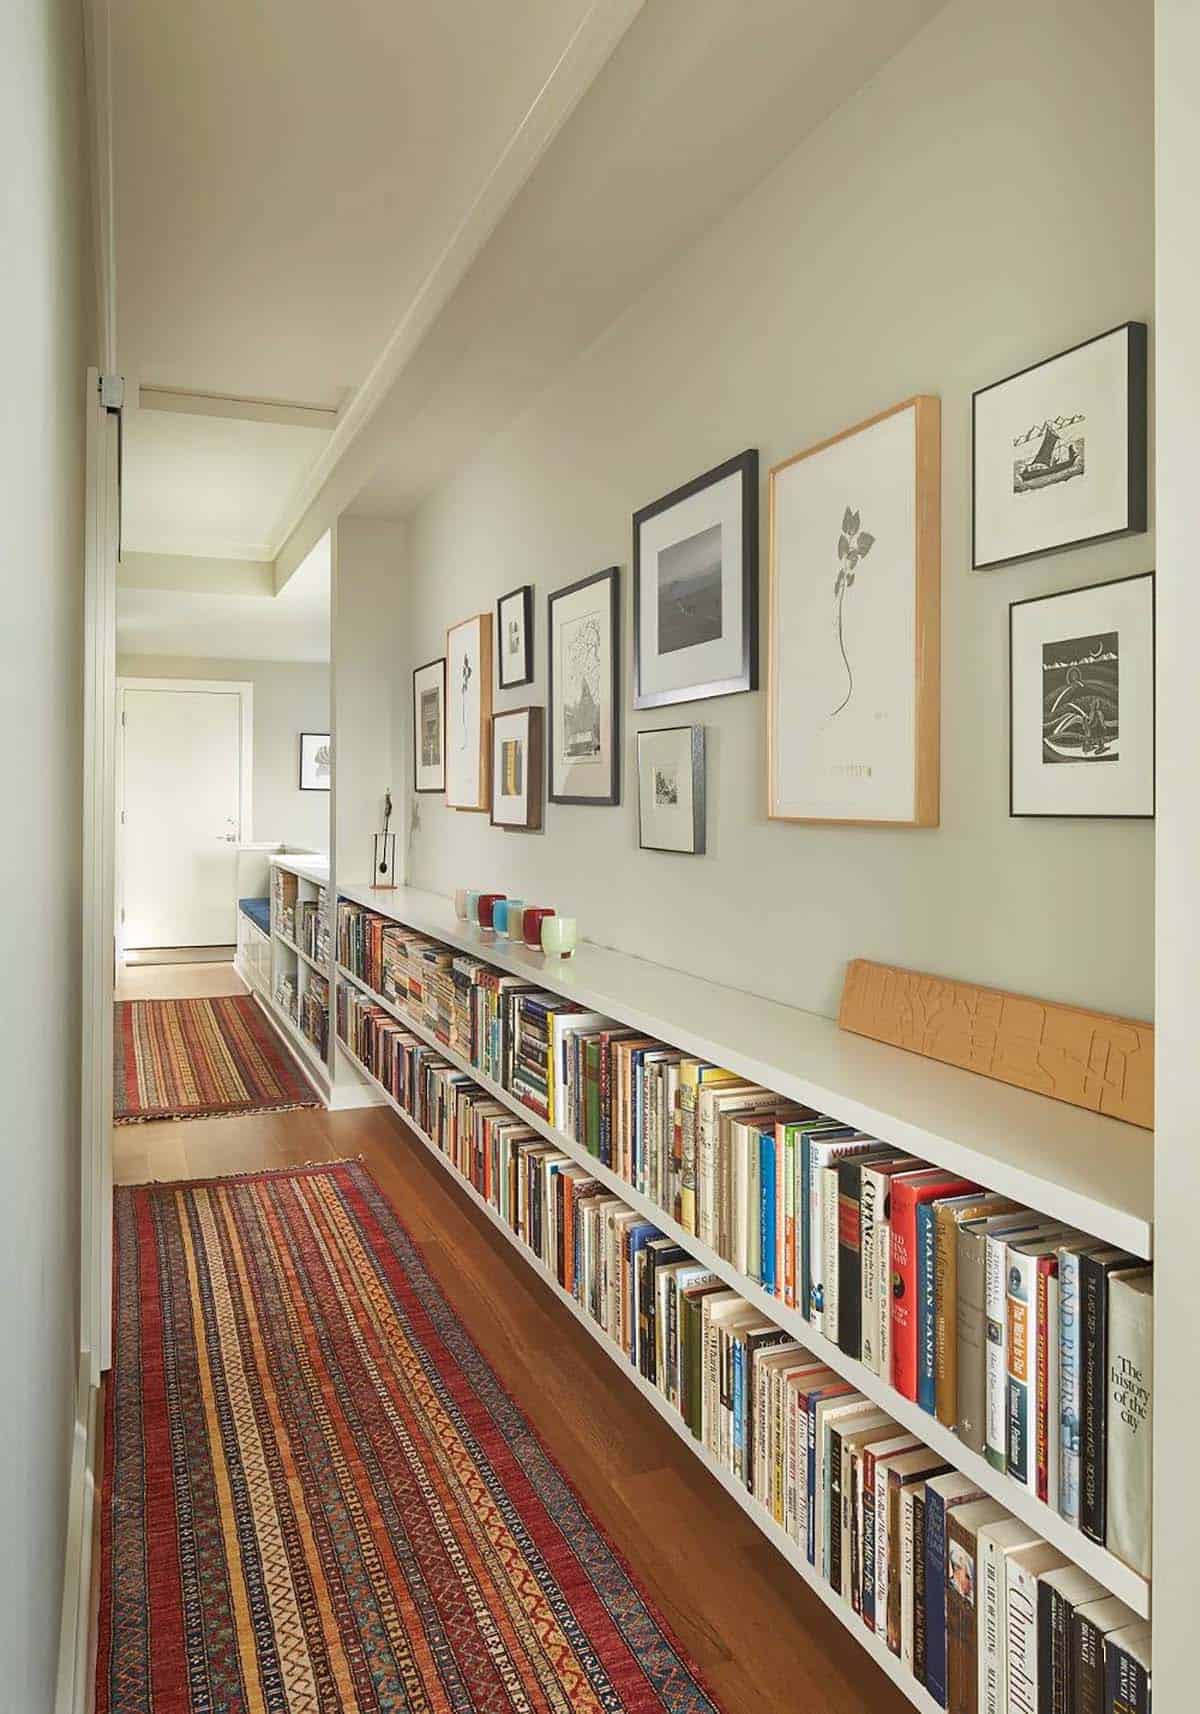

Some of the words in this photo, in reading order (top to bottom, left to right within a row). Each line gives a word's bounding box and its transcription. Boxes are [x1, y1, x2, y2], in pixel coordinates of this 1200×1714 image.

[926, 1217, 934, 1308] ARABIAN
[1061, 1263, 1075, 1328] SAND
[926, 1312, 934, 1379] SANDS
[1014, 1322, 1025, 1346] World
[1061, 1335, 1075, 1419] RIVERS
[1088, 1355, 1096, 1401] American
[1110, 1366, 1151, 1407] history
[1117, 1355, 1142, 1382] The
[1010, 1384, 1021, 1417] Thomas
[1113, 1389, 1128, 1407] of
[1128, 1393, 1148, 1420] the
[1120, 1408, 1139, 1434] city
[1010, 1426, 1021, 1465] Friedman
[904, 1500, 912, 1533] BAD
[904, 1535, 912, 1577] LAND
[987, 1561, 995, 1582] THE
[987, 1583, 995, 1604] ART
[987, 1617, 995, 1655] EATING
[1008, 1587, 1034, 1714] Churchill
[1081, 1621, 1090, 1664] BRANCH
[1087, 1626, 1097, 1669] TAYLOR
[1120, 1656, 1129, 1701] BRANCH
